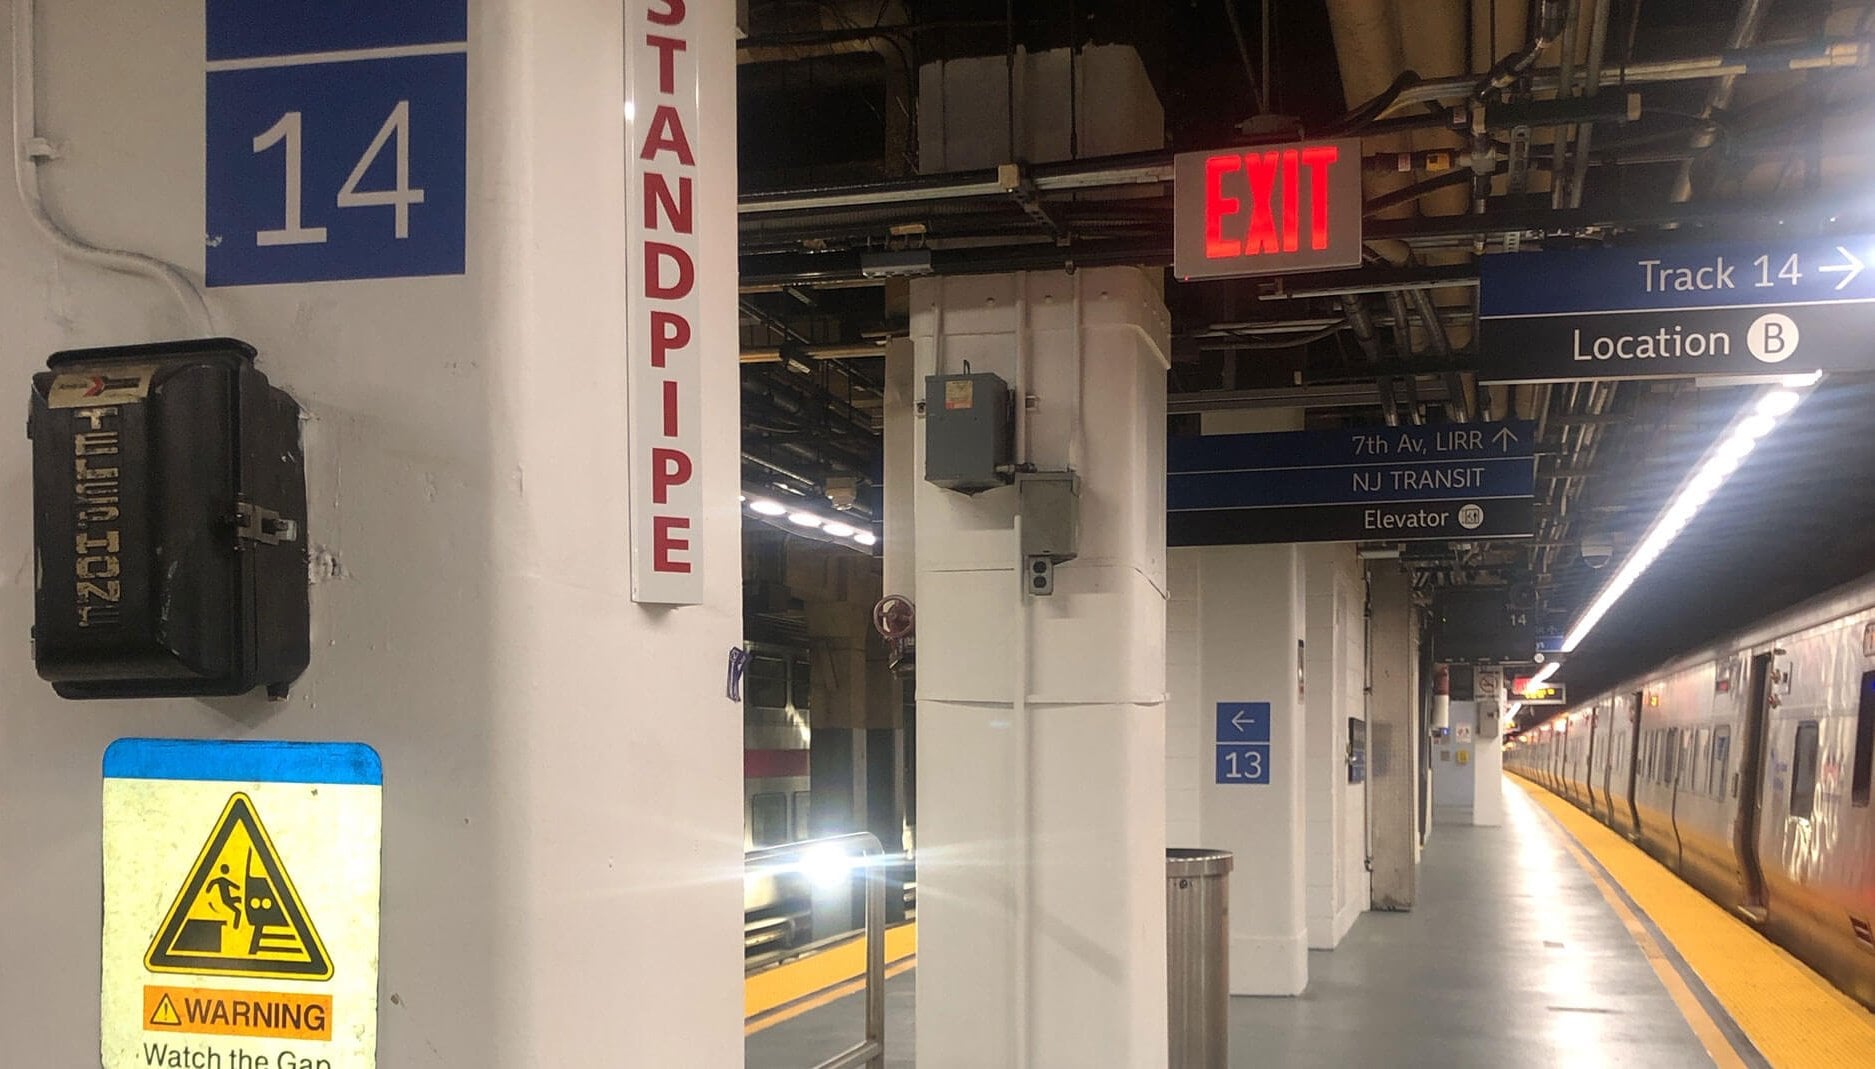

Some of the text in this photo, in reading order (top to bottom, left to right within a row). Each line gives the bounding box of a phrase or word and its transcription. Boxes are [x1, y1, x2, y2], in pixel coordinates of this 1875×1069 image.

[253, 101, 425, 246] 14
[1205, 146, 1338, 258] EXIT
[1638, 253, 1803, 292] Track 14
[1573, 322, 1785, 361] Location B
[1352, 431, 1483, 455] 7th Av, LIRR
[1353, 467, 1485, 492] NJ TRANSIT
[1364, 509, 1449, 529] Elevator
[1225, 751, 1262, 779] 13
[185, 998, 325, 1031] WARNING
[144, 1043, 221, 1069] Watch
[229, 1048, 268, 1069] the
